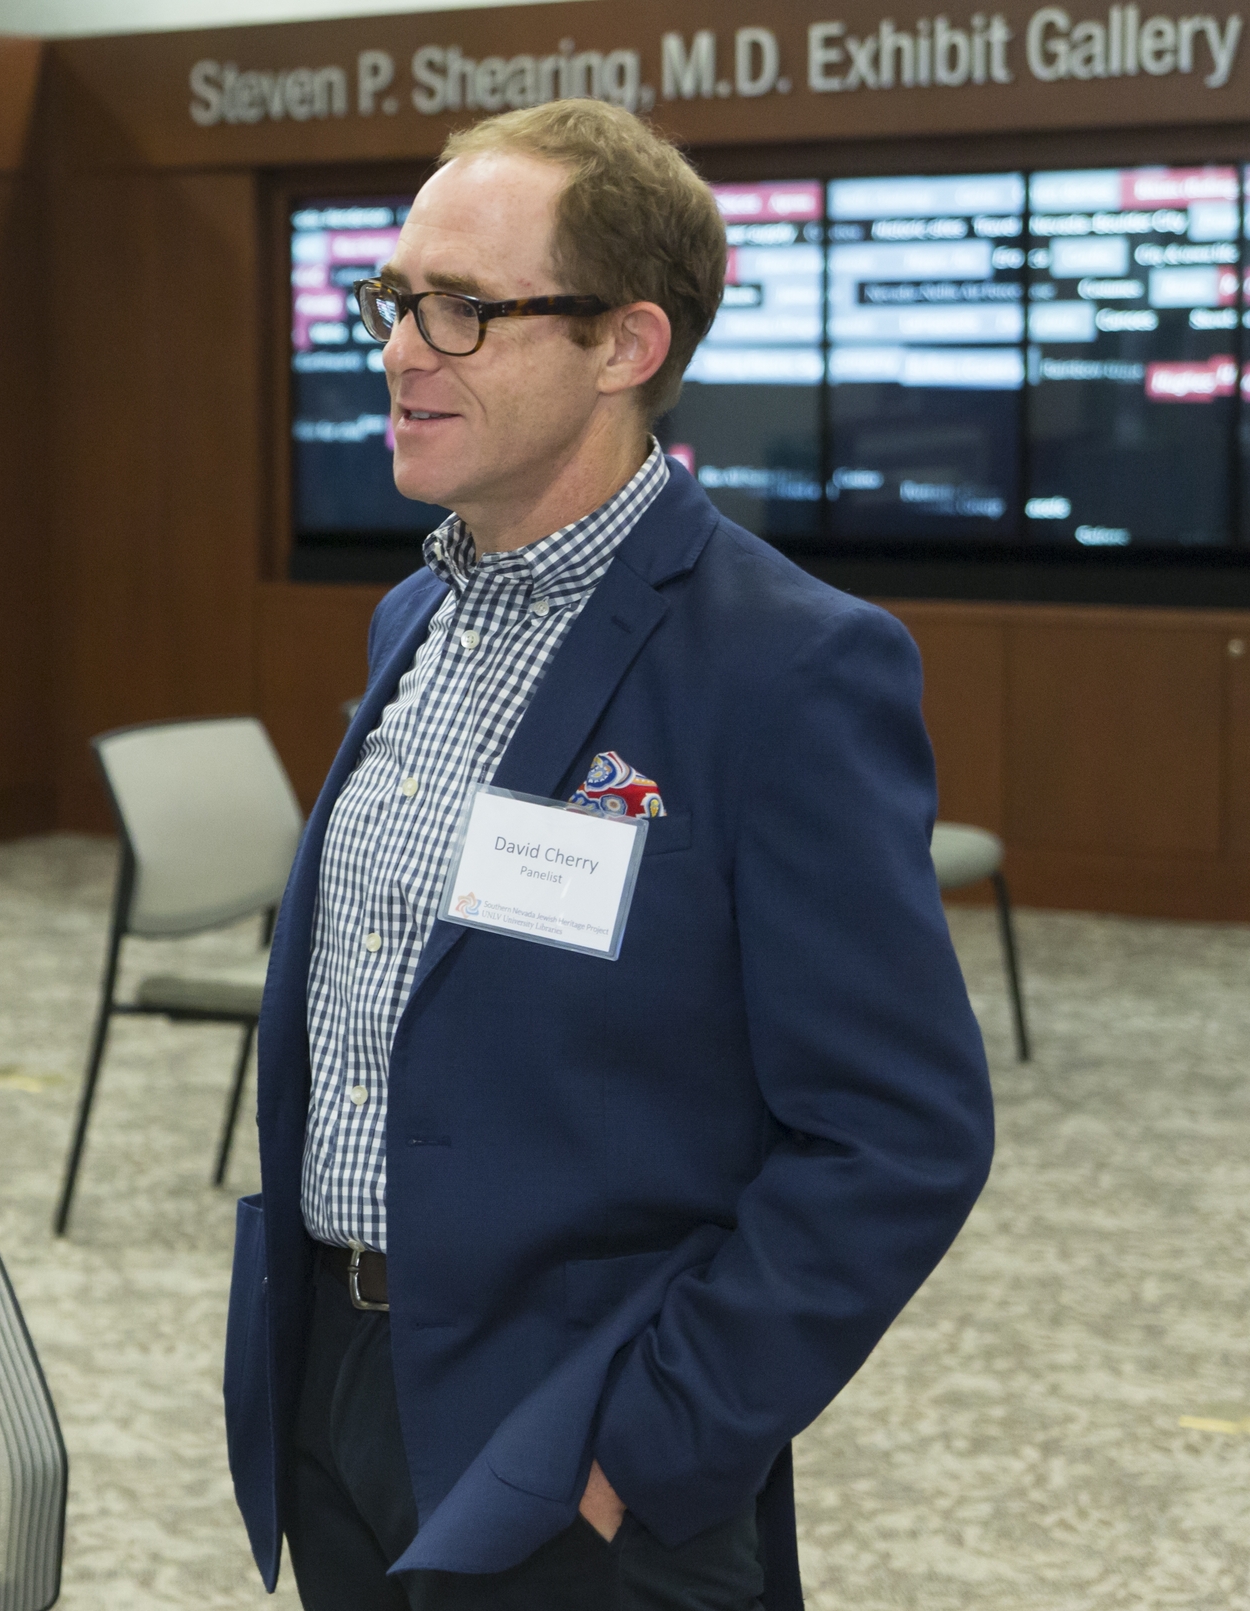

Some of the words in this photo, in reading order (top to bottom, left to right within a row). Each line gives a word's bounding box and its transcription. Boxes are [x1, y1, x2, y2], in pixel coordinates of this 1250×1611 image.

[189, 58, 348, 126] Steven
[357, 50, 398, 116] P.
[411, 37, 655, 115] Shearing,
[661, 29, 792, 98] M.D.
[808, 13, 1012, 92] Exhibit
[1026, 3, 1242, 88] Gallery
[494, 836, 540, 859] David
[544, 847, 599, 875] Cherry
[520, 865, 563, 884] Panelist
[481, 910, 502, 920] UNLV
[503, 915, 534, 930] University
[535, 922, 562, 935] Libraries
[483, 900, 511, 913] Southern
[513, 907, 536, 919] Nevada
[536, 912, 557, 923] Jewish
[558, 918, 585, 930] Heritage
[586, 923, 609, 935] Project
